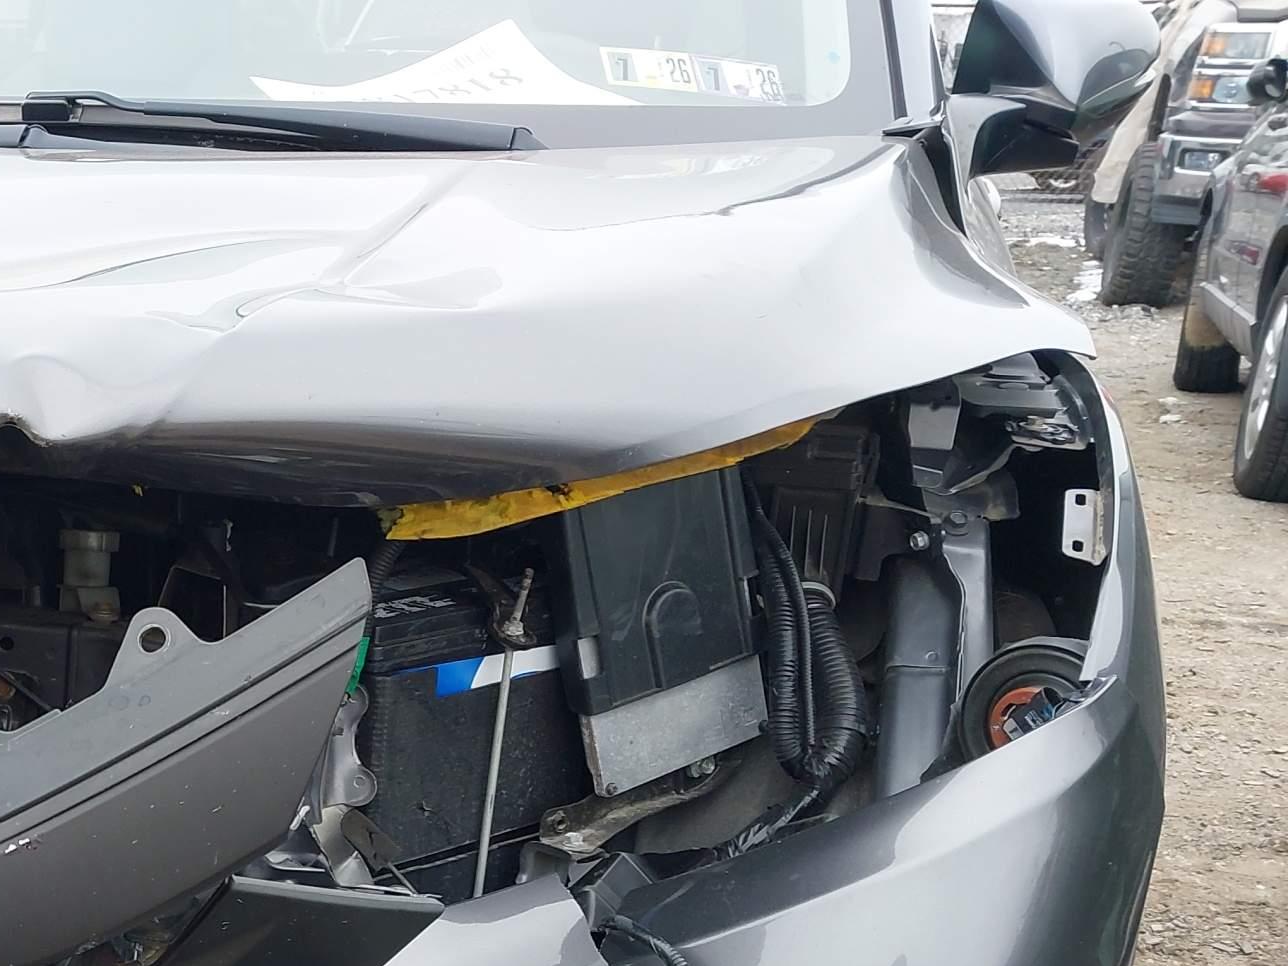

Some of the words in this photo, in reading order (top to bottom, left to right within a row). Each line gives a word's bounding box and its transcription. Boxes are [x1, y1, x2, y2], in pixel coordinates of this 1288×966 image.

[615, 57, 630, 82] 7
[665, 57, 693, 85] 26
[706, 66, 721, 92] 7
[756, 68, 784, 98] 26
